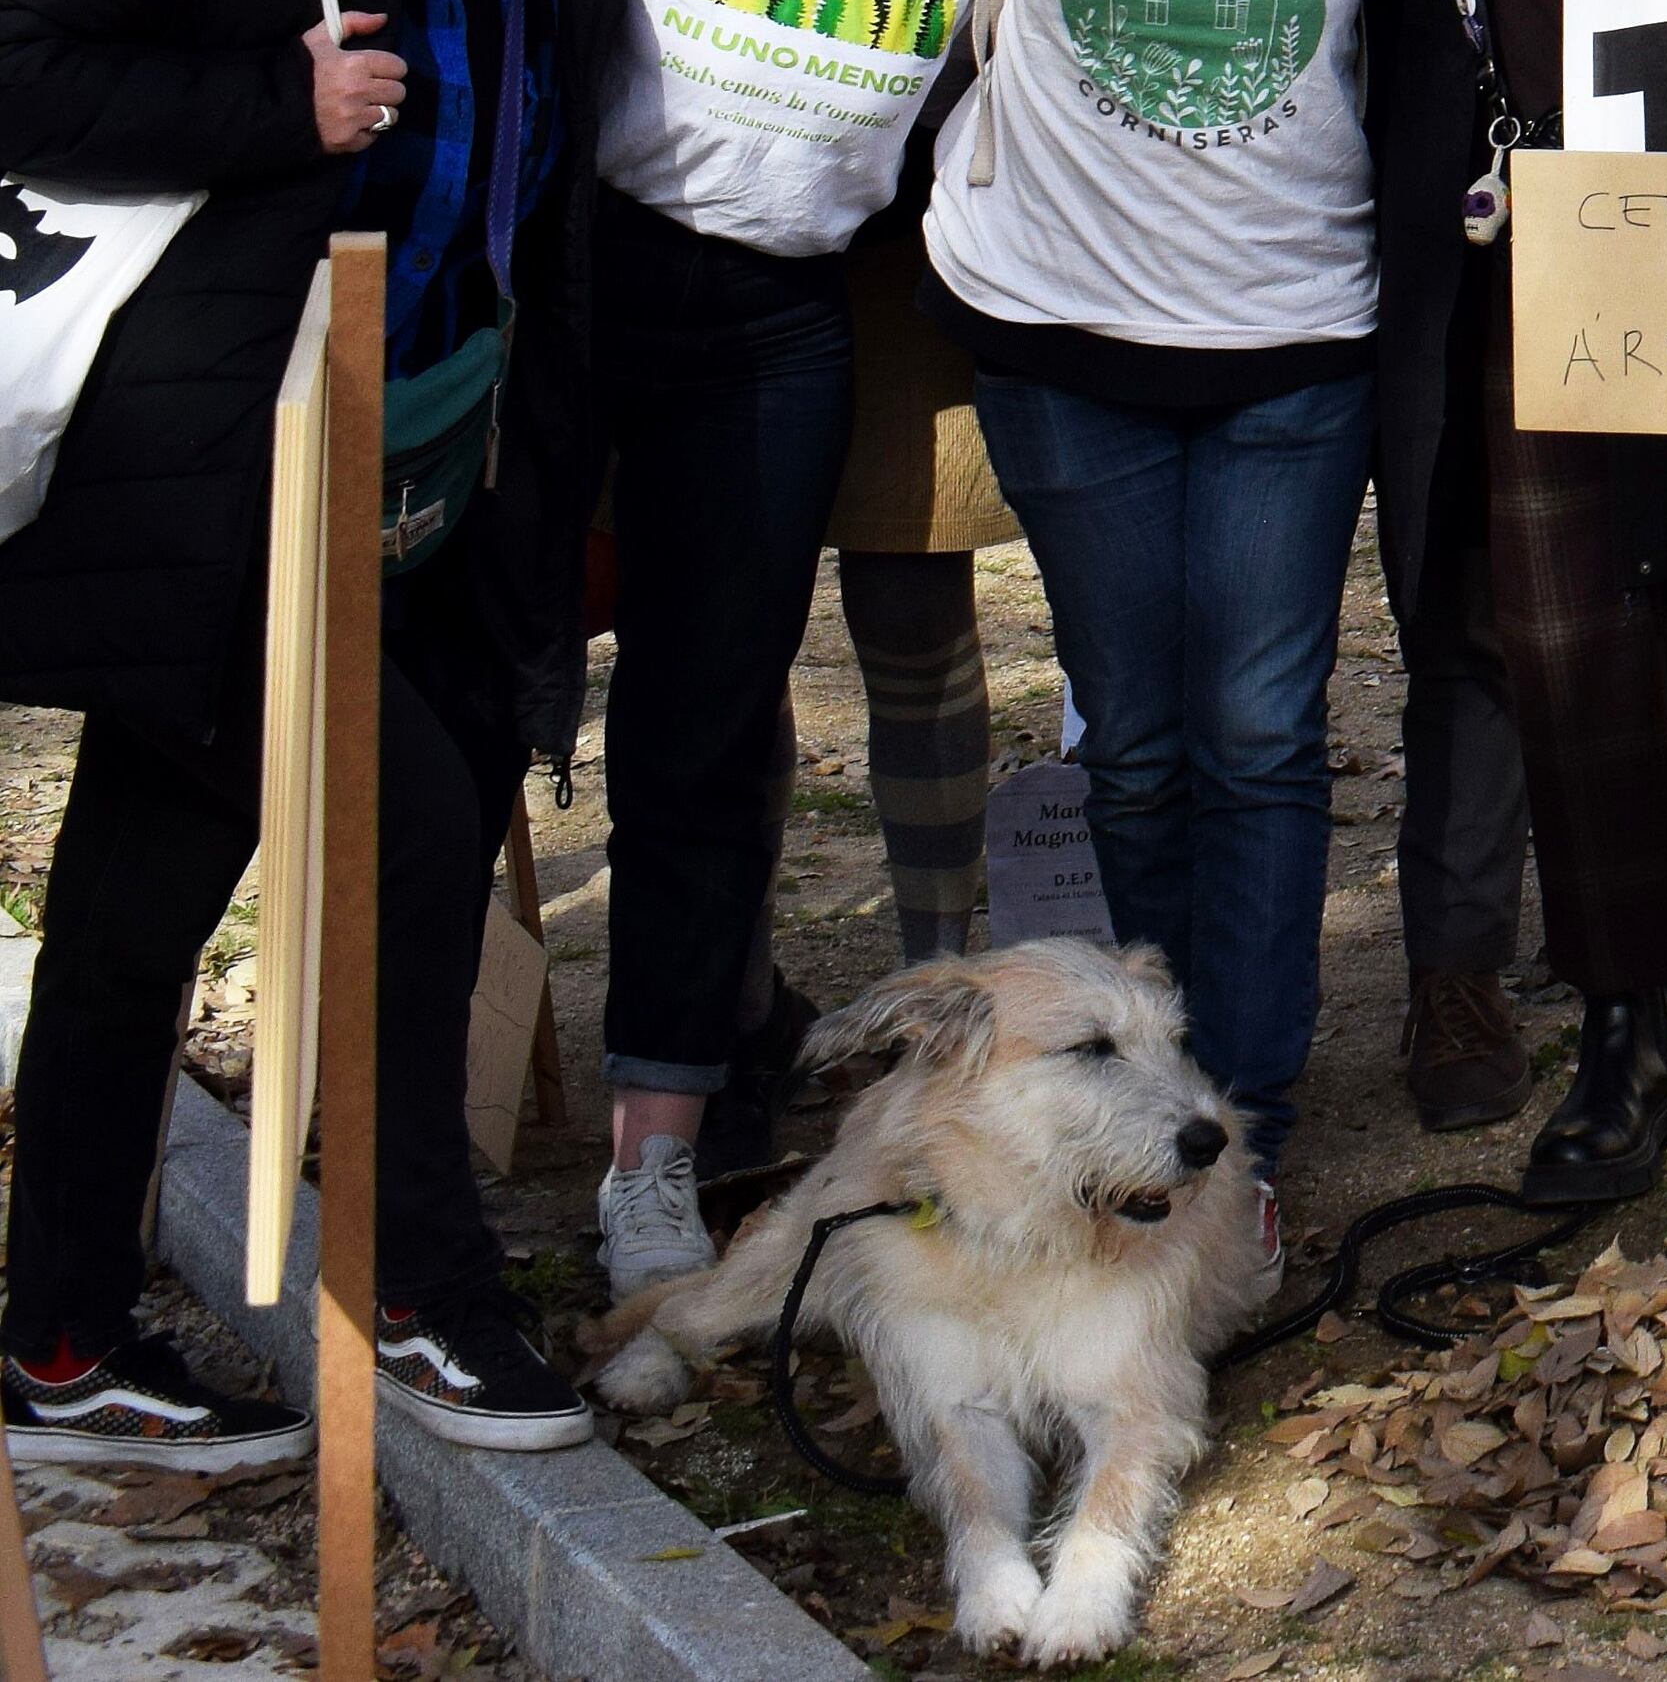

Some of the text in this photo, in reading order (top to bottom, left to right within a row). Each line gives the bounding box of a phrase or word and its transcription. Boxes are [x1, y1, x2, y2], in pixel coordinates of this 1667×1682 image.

[662, 6, 925, 97] NI UNO MENOS
[785, 90, 808, 113] la
[1076, 76, 1303, 152] CORNISERAS
[1012, 829, 1090, 850] Magno
[1054, 870, 1094, 888] D.E.P
